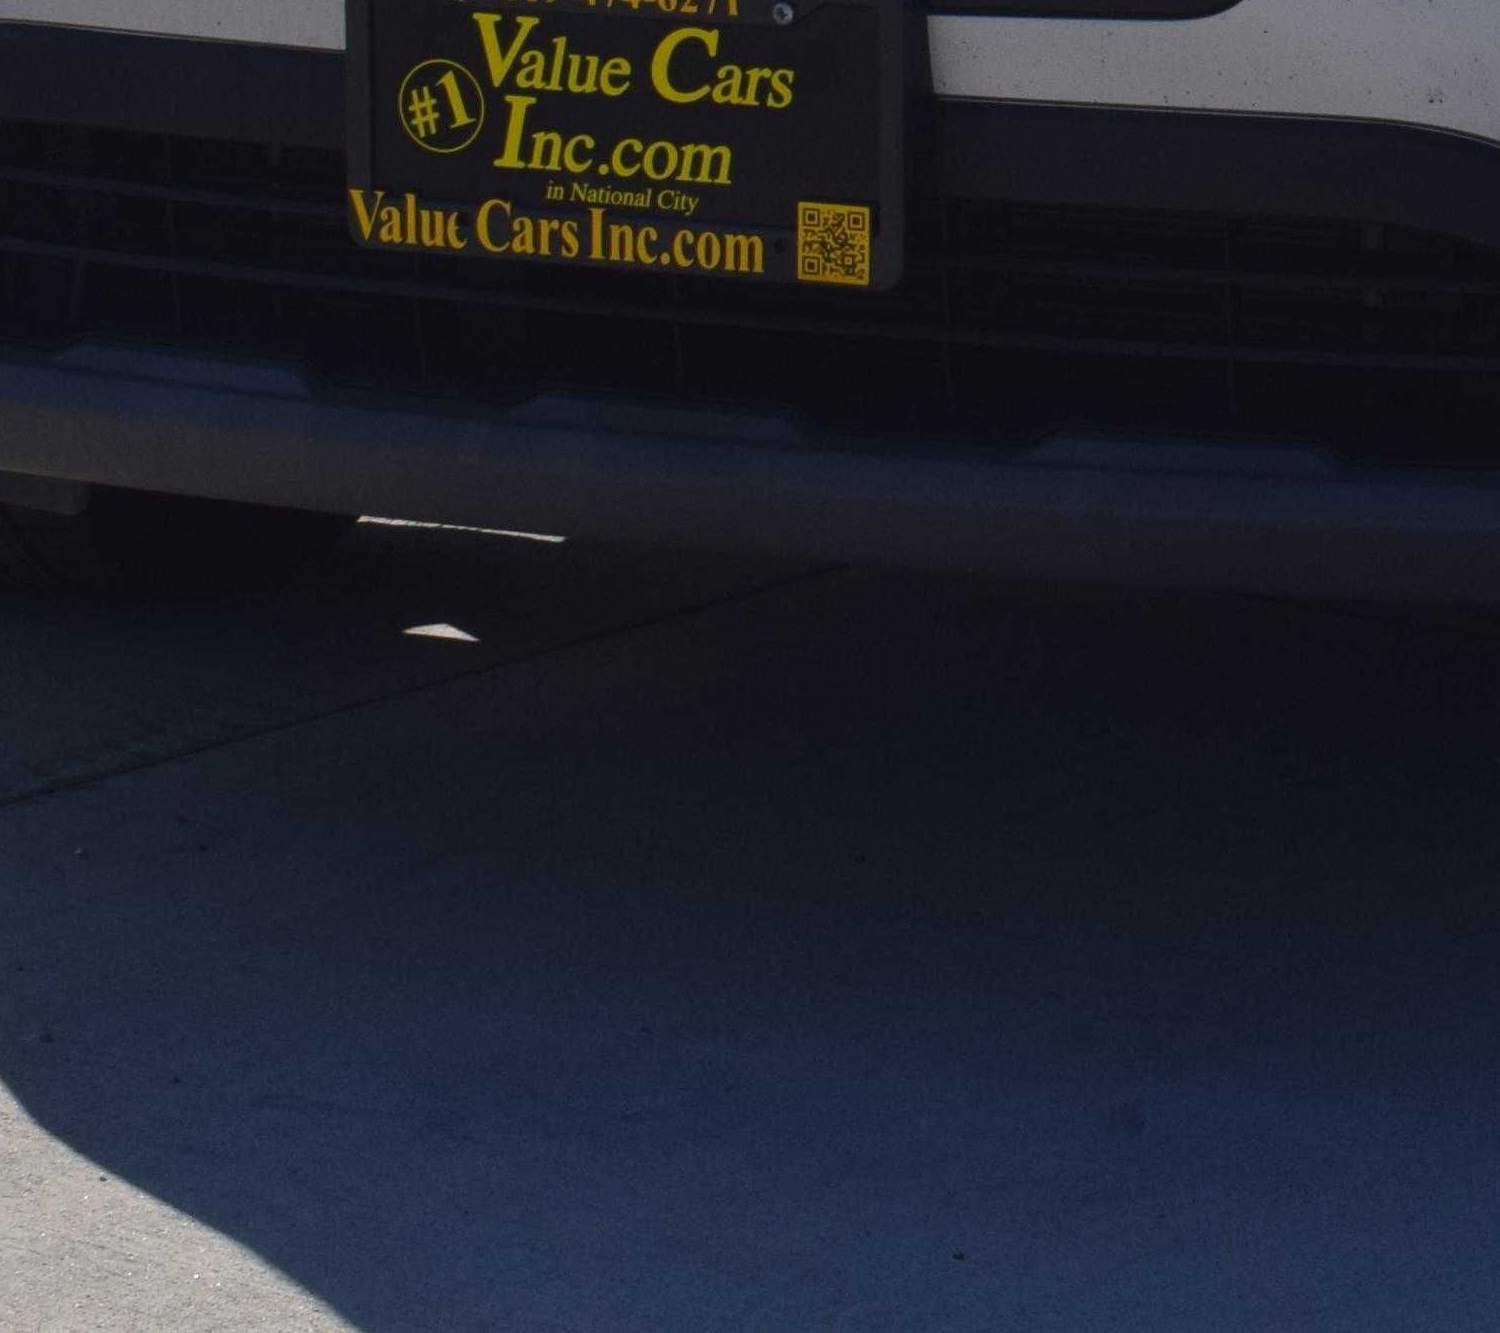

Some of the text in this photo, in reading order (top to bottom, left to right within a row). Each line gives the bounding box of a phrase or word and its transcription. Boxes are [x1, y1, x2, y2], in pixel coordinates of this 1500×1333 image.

[473, 11, 795, 109] Value Cars
[407, 70, 477, 139] #1
[493, 94, 733, 186] Inc.com
[545, 180, 700, 215] in National City
[475, 198, 579, 261] Cars
[588, 207, 765, 275] Inc.com
